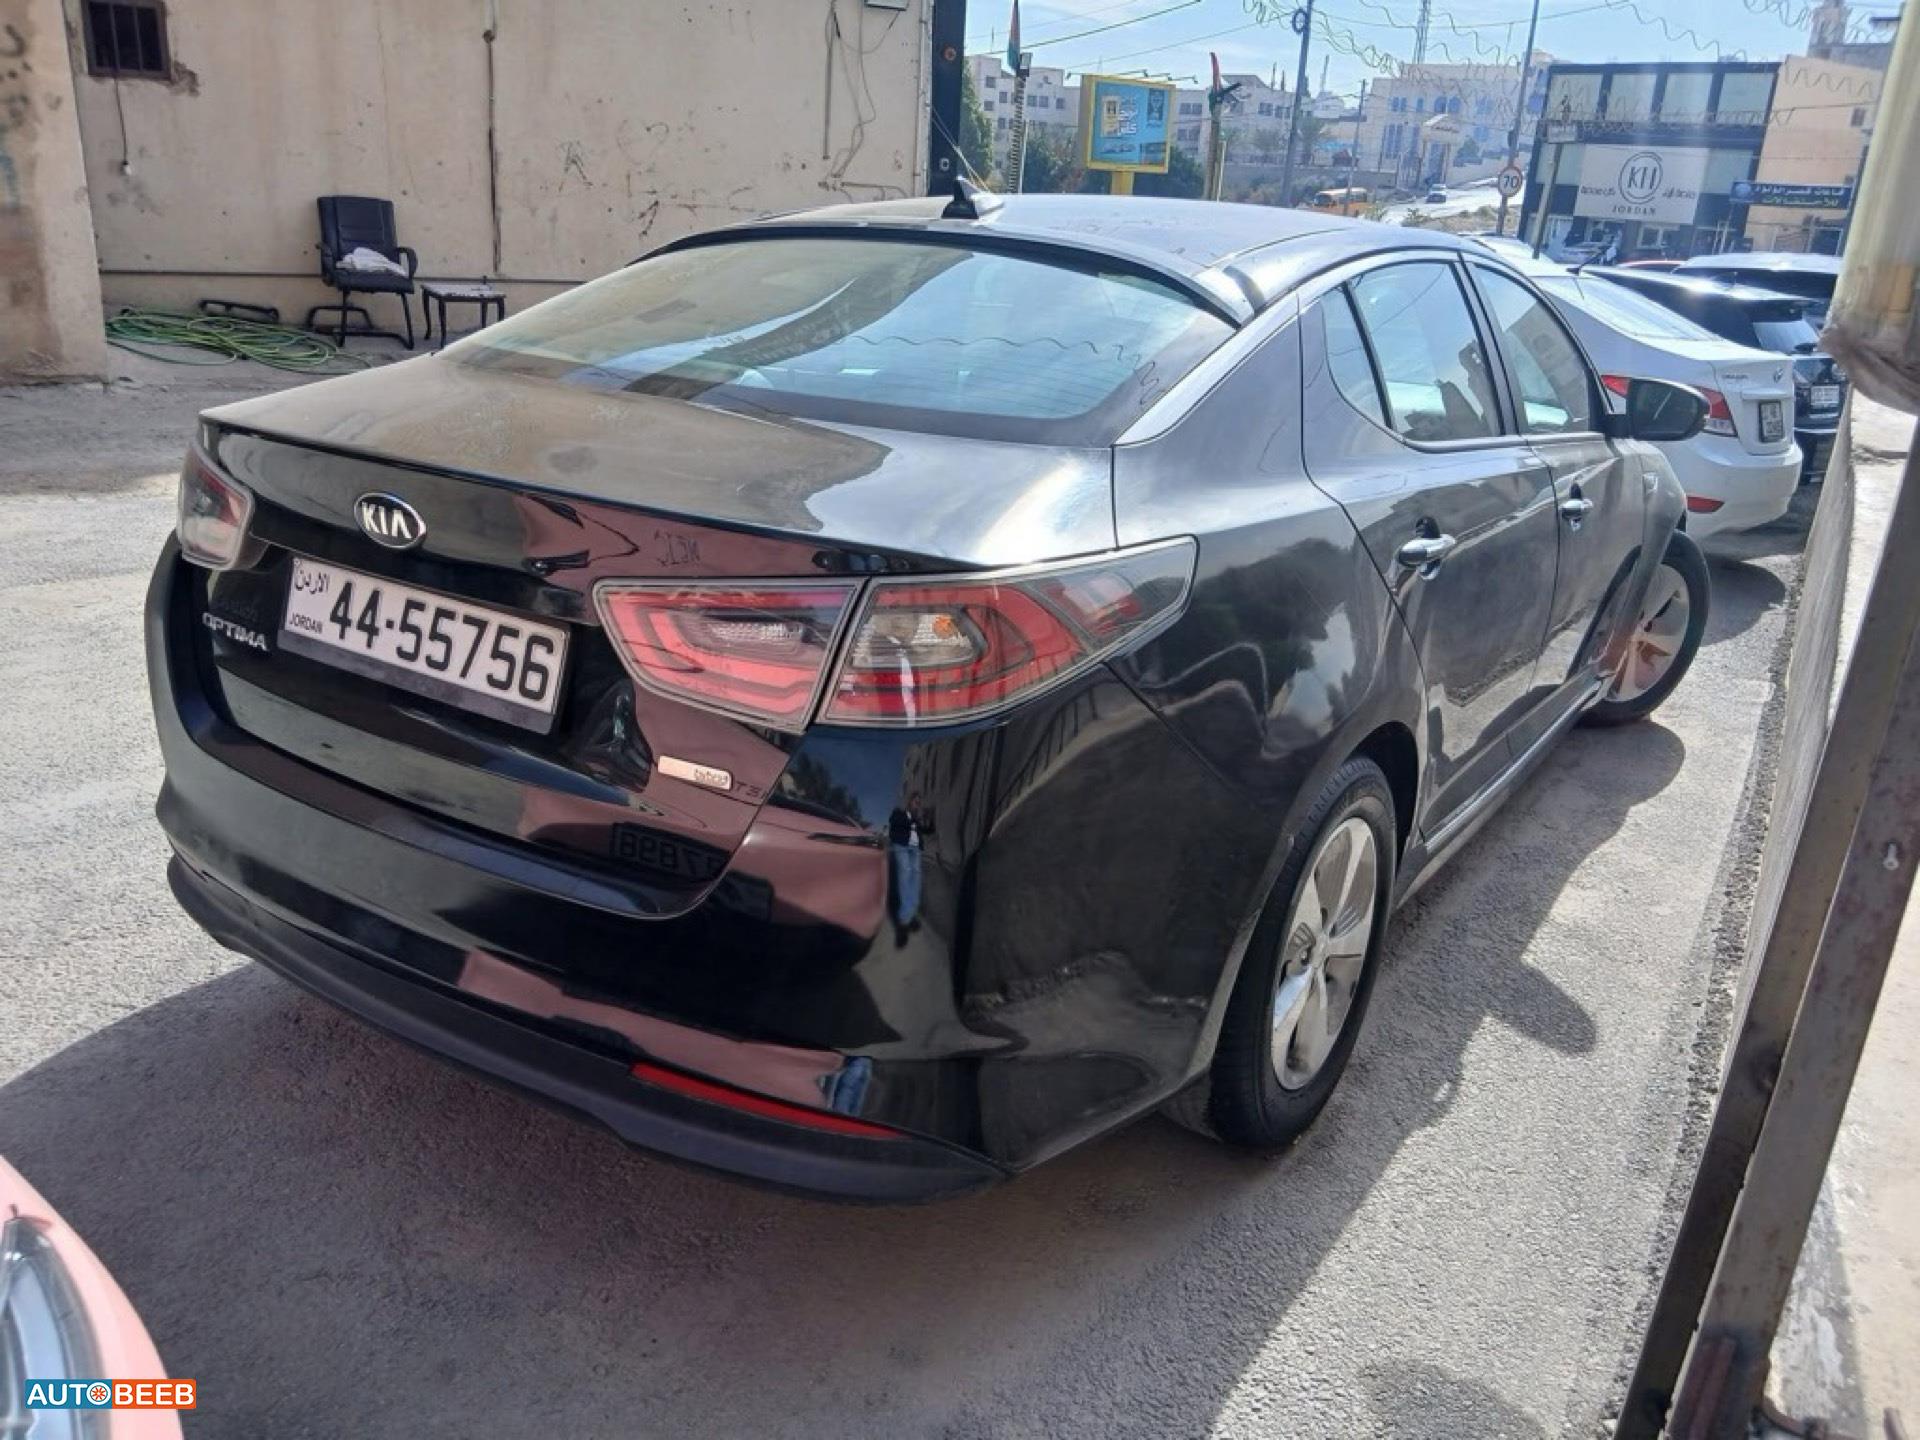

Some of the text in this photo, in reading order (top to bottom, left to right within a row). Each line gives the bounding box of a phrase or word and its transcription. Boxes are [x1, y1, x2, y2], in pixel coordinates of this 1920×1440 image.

[1503, 175, 1520, 188] 70
[1612, 205, 1656, 216] JORDAN
[361, 501, 412, 539] KIA
[202, 612, 268, 652] OPTIMA
[289, 611, 324, 635] JORDAN
[329, 580, 554, 702] 44-55756
